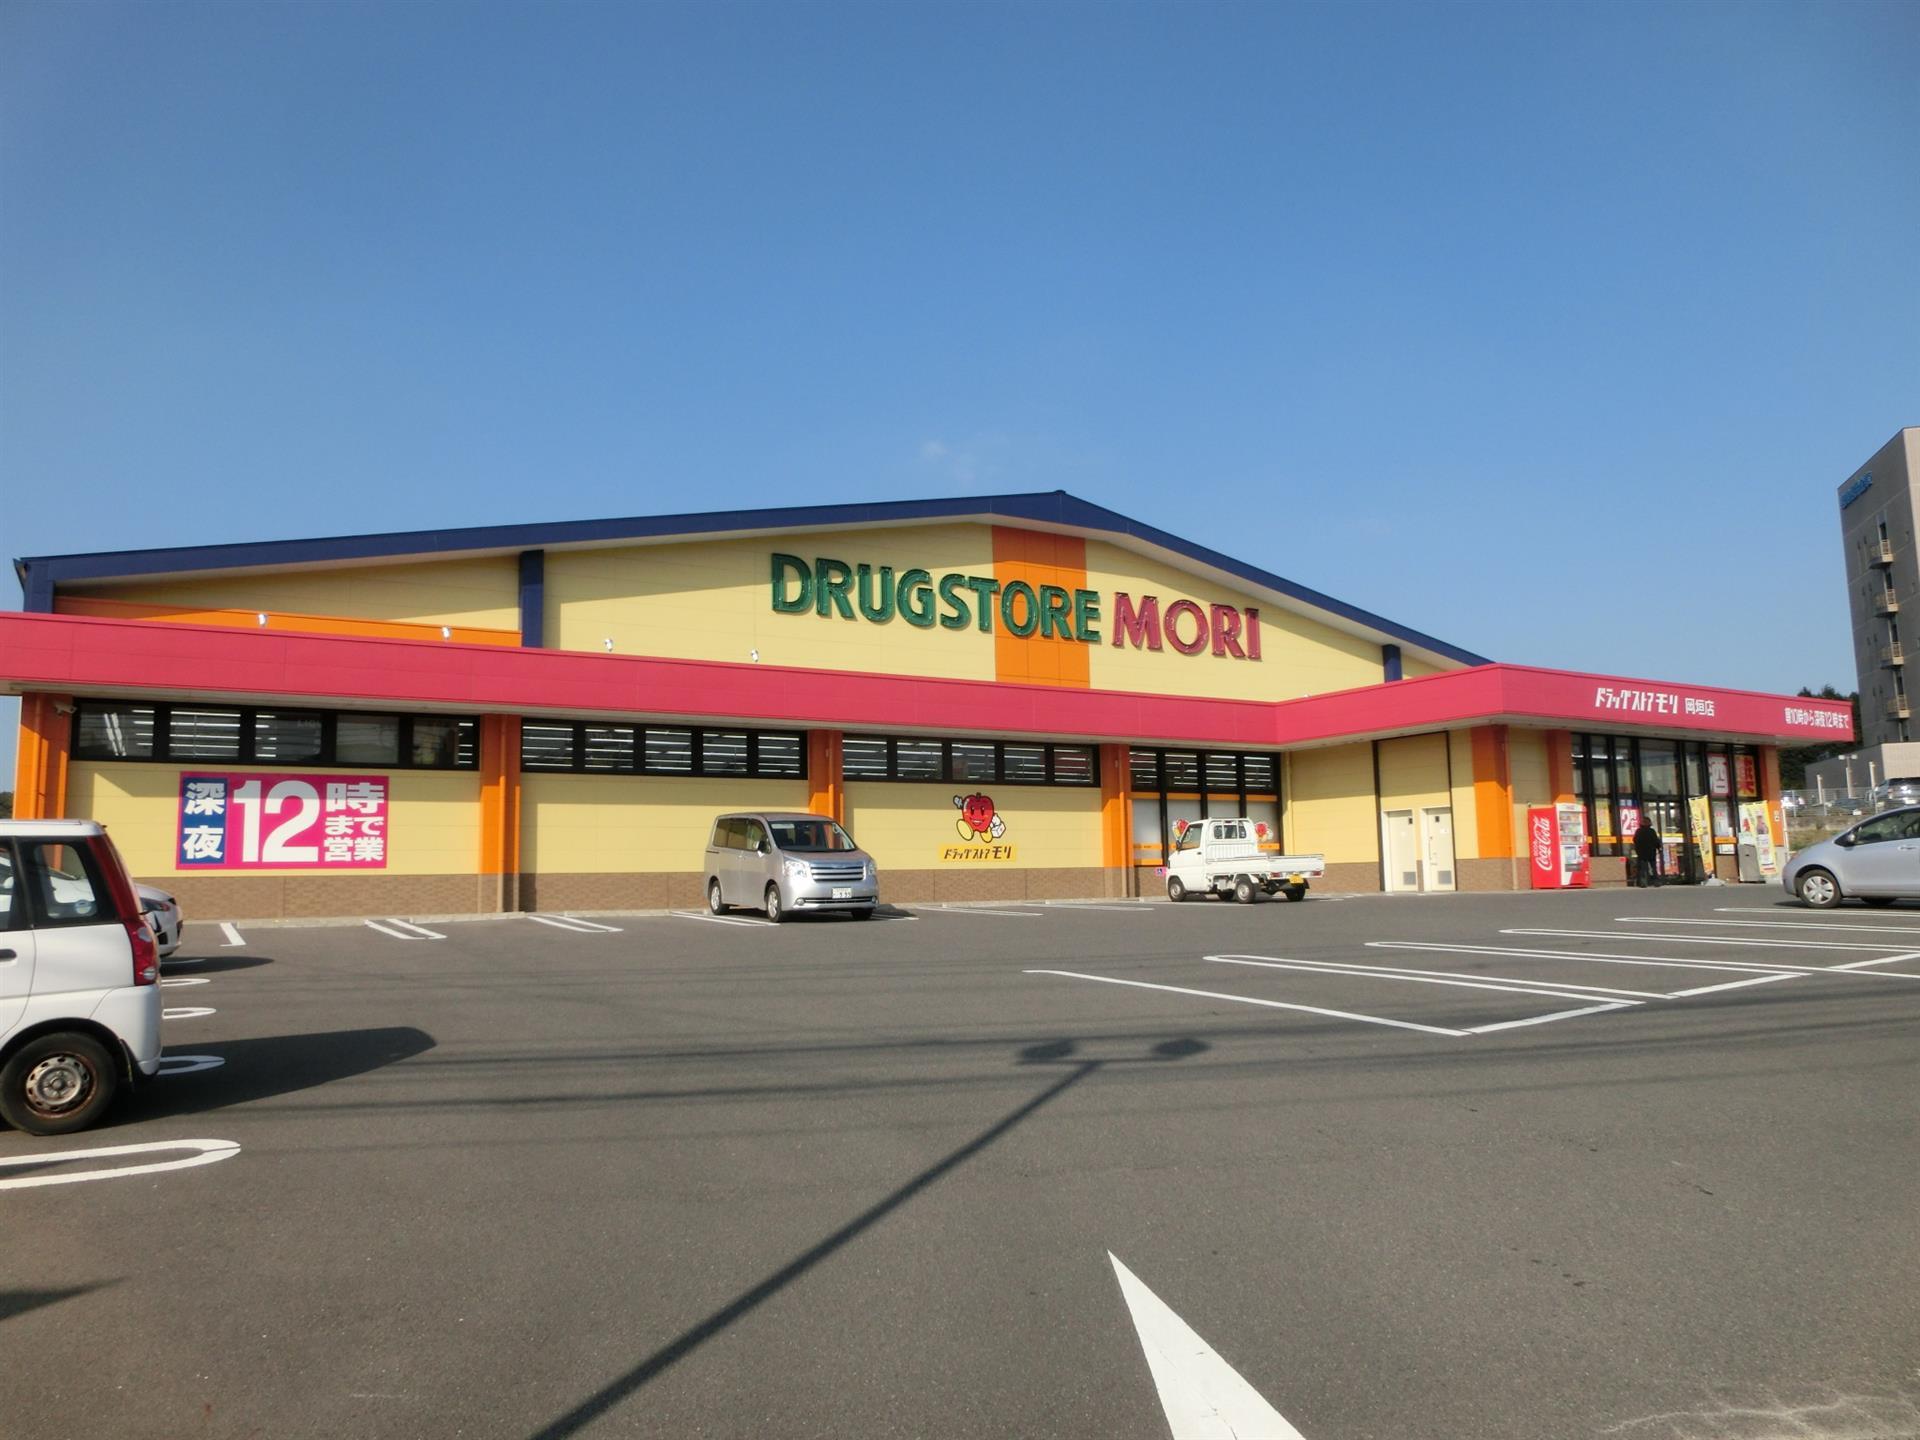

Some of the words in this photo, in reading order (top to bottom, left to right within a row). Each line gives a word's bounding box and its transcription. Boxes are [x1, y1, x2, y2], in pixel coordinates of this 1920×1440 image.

[771, 553, 1101, 643] DRUGSTORE
[1113, 592, 1262, 660] MORI
[1685, 698, 1715, 716] 岡垣店
[184, 783, 225, 859] 深夜
[233, 780, 320, 862] 12
[325, 816, 384, 835] まで
[324, 837, 384, 861] 営業
